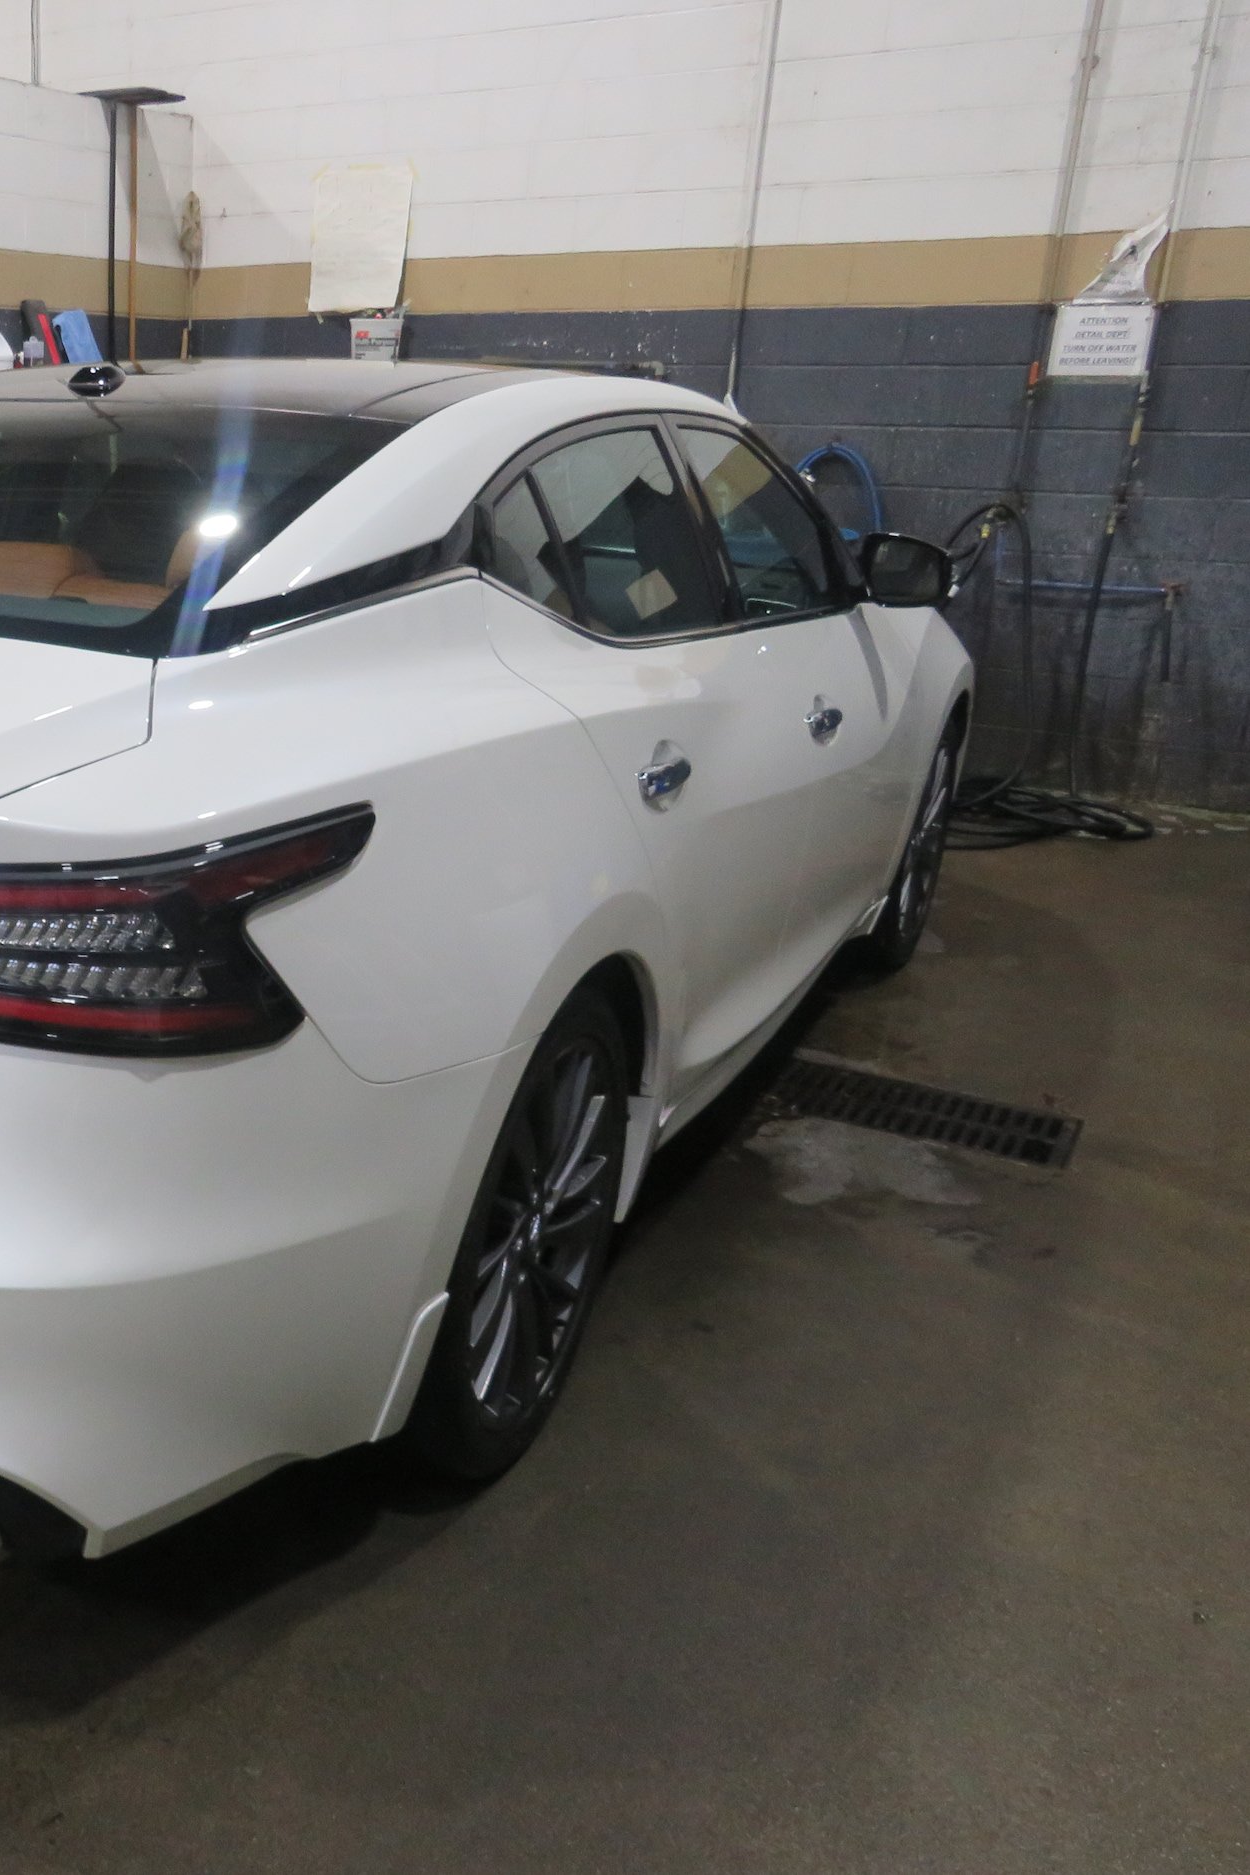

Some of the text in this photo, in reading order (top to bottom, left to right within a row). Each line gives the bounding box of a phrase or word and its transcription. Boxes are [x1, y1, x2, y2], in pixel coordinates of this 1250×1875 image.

[1078, 316, 1129, 325] ATTENTION
[1074, 330, 1104, 339] DETAIL
[1062, 344, 1137, 353] TURN OFF WATER
[1058, 357, 1090, 366] BEFORE
